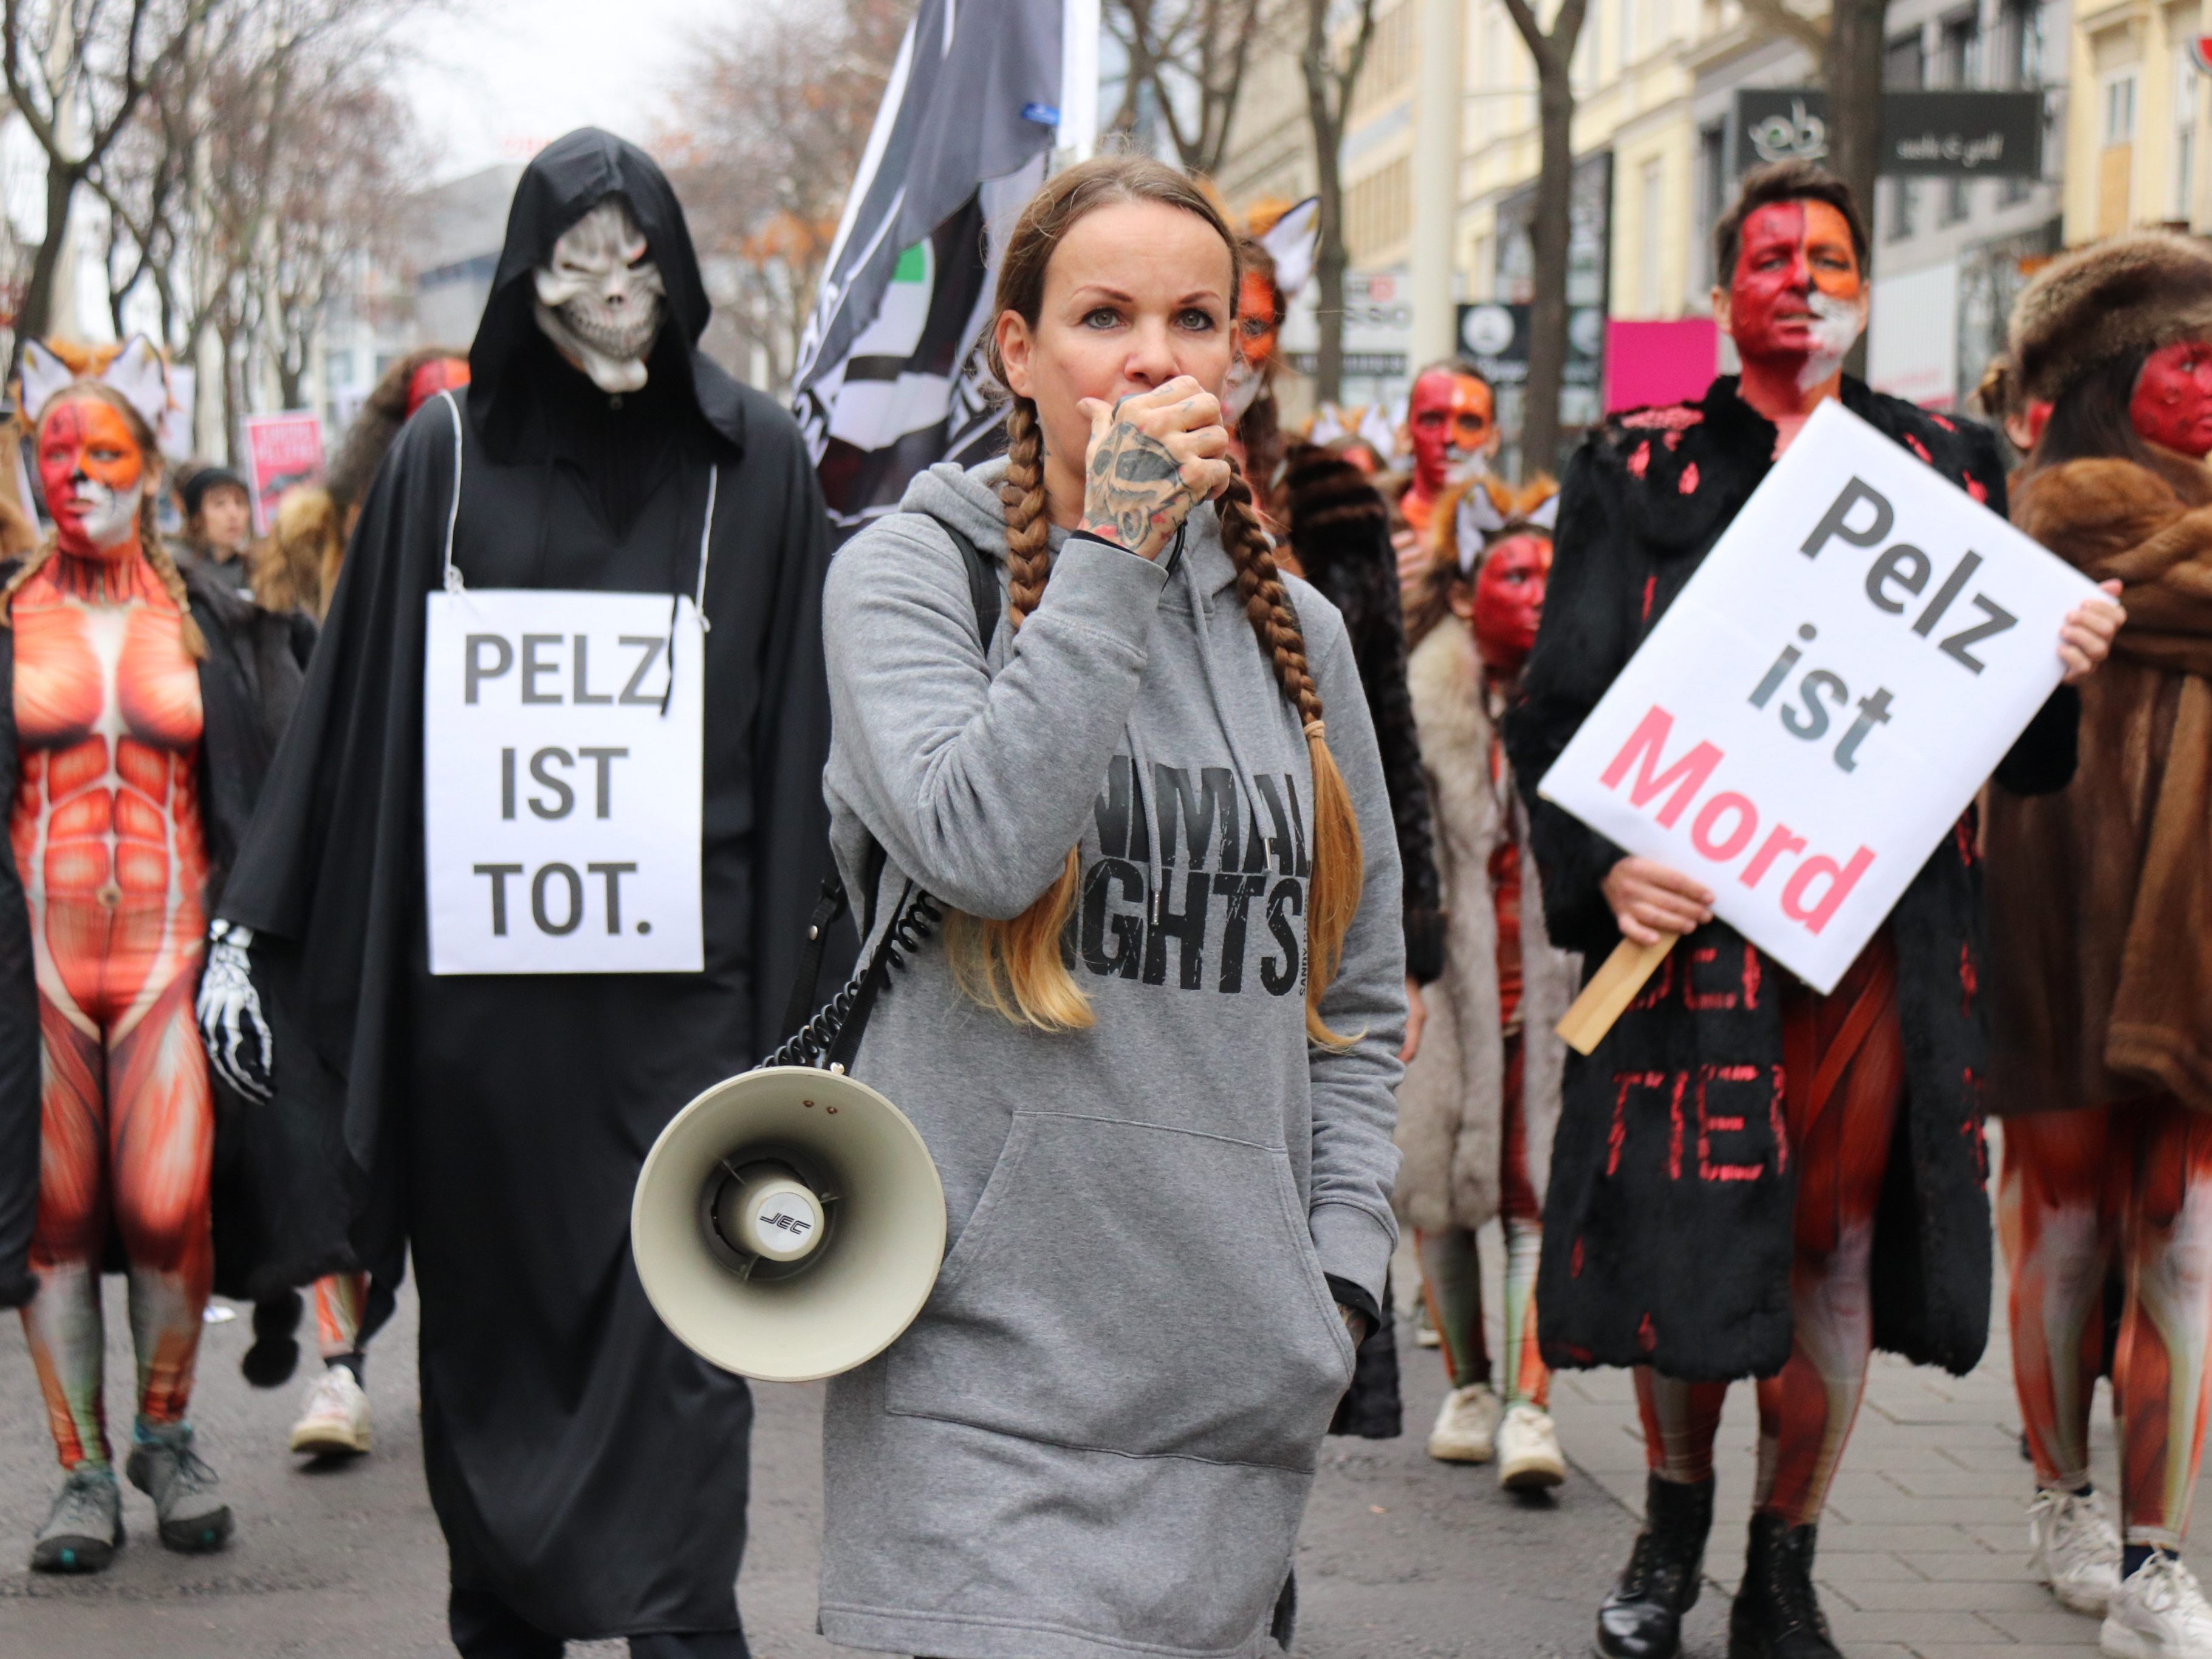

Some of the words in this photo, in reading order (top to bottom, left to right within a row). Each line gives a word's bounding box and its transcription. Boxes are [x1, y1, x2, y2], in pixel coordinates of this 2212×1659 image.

[1799, 476, 2018, 675] Pelz
[465, 634, 667, 705] PELZ
[1748, 624, 1893, 772] ist
[502, 747, 628, 820] IST
[1600, 706, 1875, 934] Mord
[473, 863, 652, 937] TOT.
[759, 1213, 811, 1235] JEC
